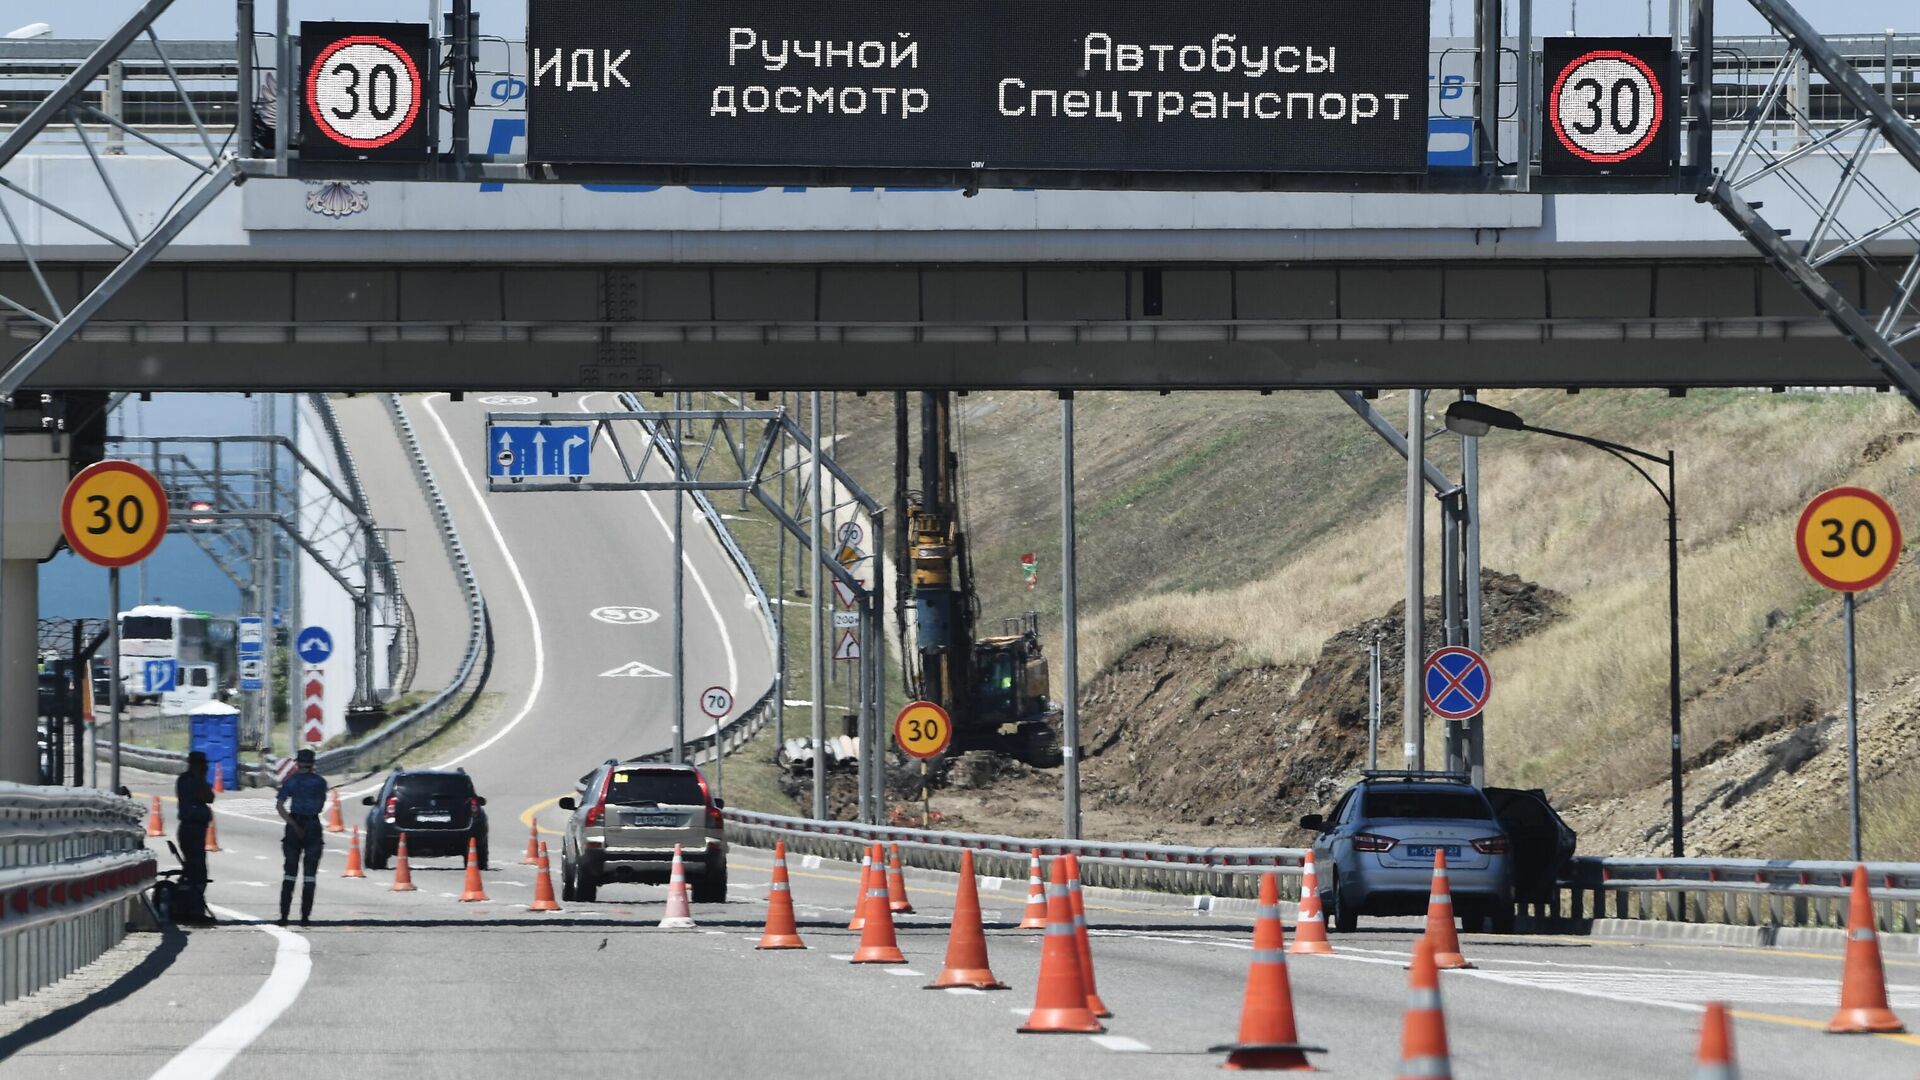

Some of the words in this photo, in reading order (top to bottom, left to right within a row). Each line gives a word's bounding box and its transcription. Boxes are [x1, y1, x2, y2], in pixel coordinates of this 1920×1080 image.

[533, 48, 631, 92] ИДК
[729, 27, 918, 71] Ручной
[1084, 32, 1336, 77] Автобусы
[331, 63, 398, 121] 30
[710, 85, 929, 120] досмотр
[998, 77, 1409, 125] Спецтранспорт
[1573, 78, 1641, 135] 30
[86, 494, 144, 535] 30
[1820, 518, 1876, 558] 30
[603, 609, 649, 620] 50
[708, 695, 726, 709] 70
[908, 719, 938, 741] 30
